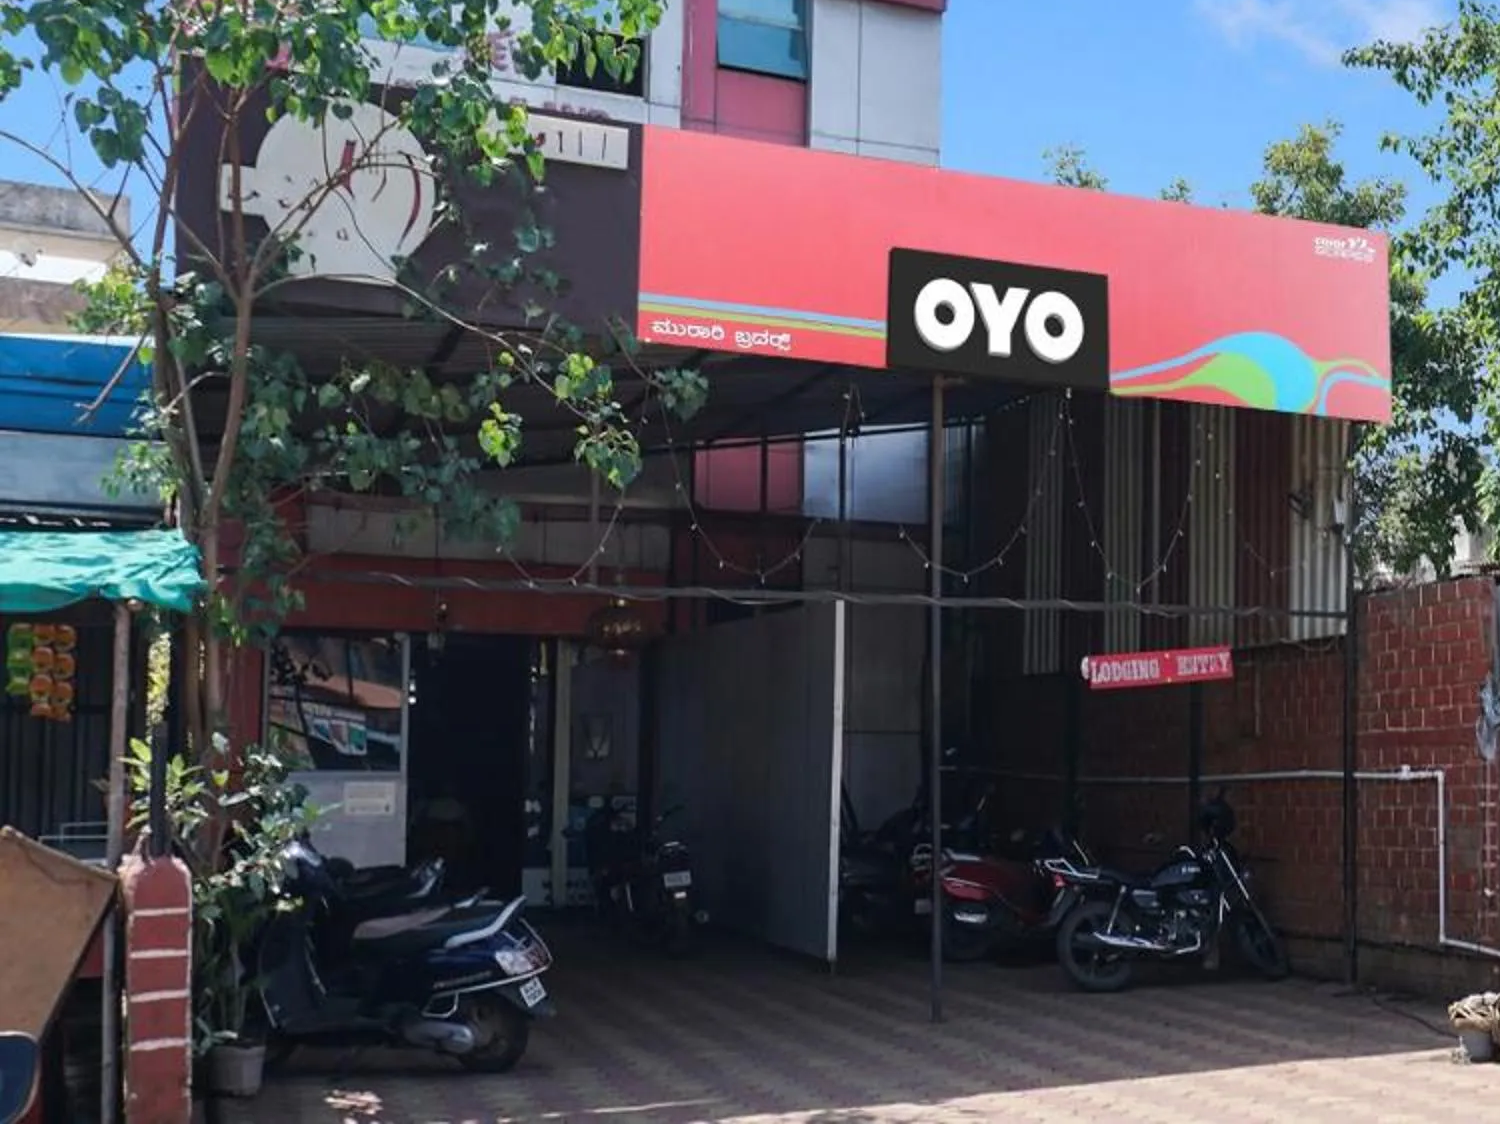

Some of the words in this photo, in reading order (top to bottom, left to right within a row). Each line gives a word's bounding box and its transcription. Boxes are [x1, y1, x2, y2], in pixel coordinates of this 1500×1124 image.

[914, 277, 1084, 364] OYO
[1090, 659, 1160, 683] LODGING
[1177, 652, 1231, 676] ENTRY
